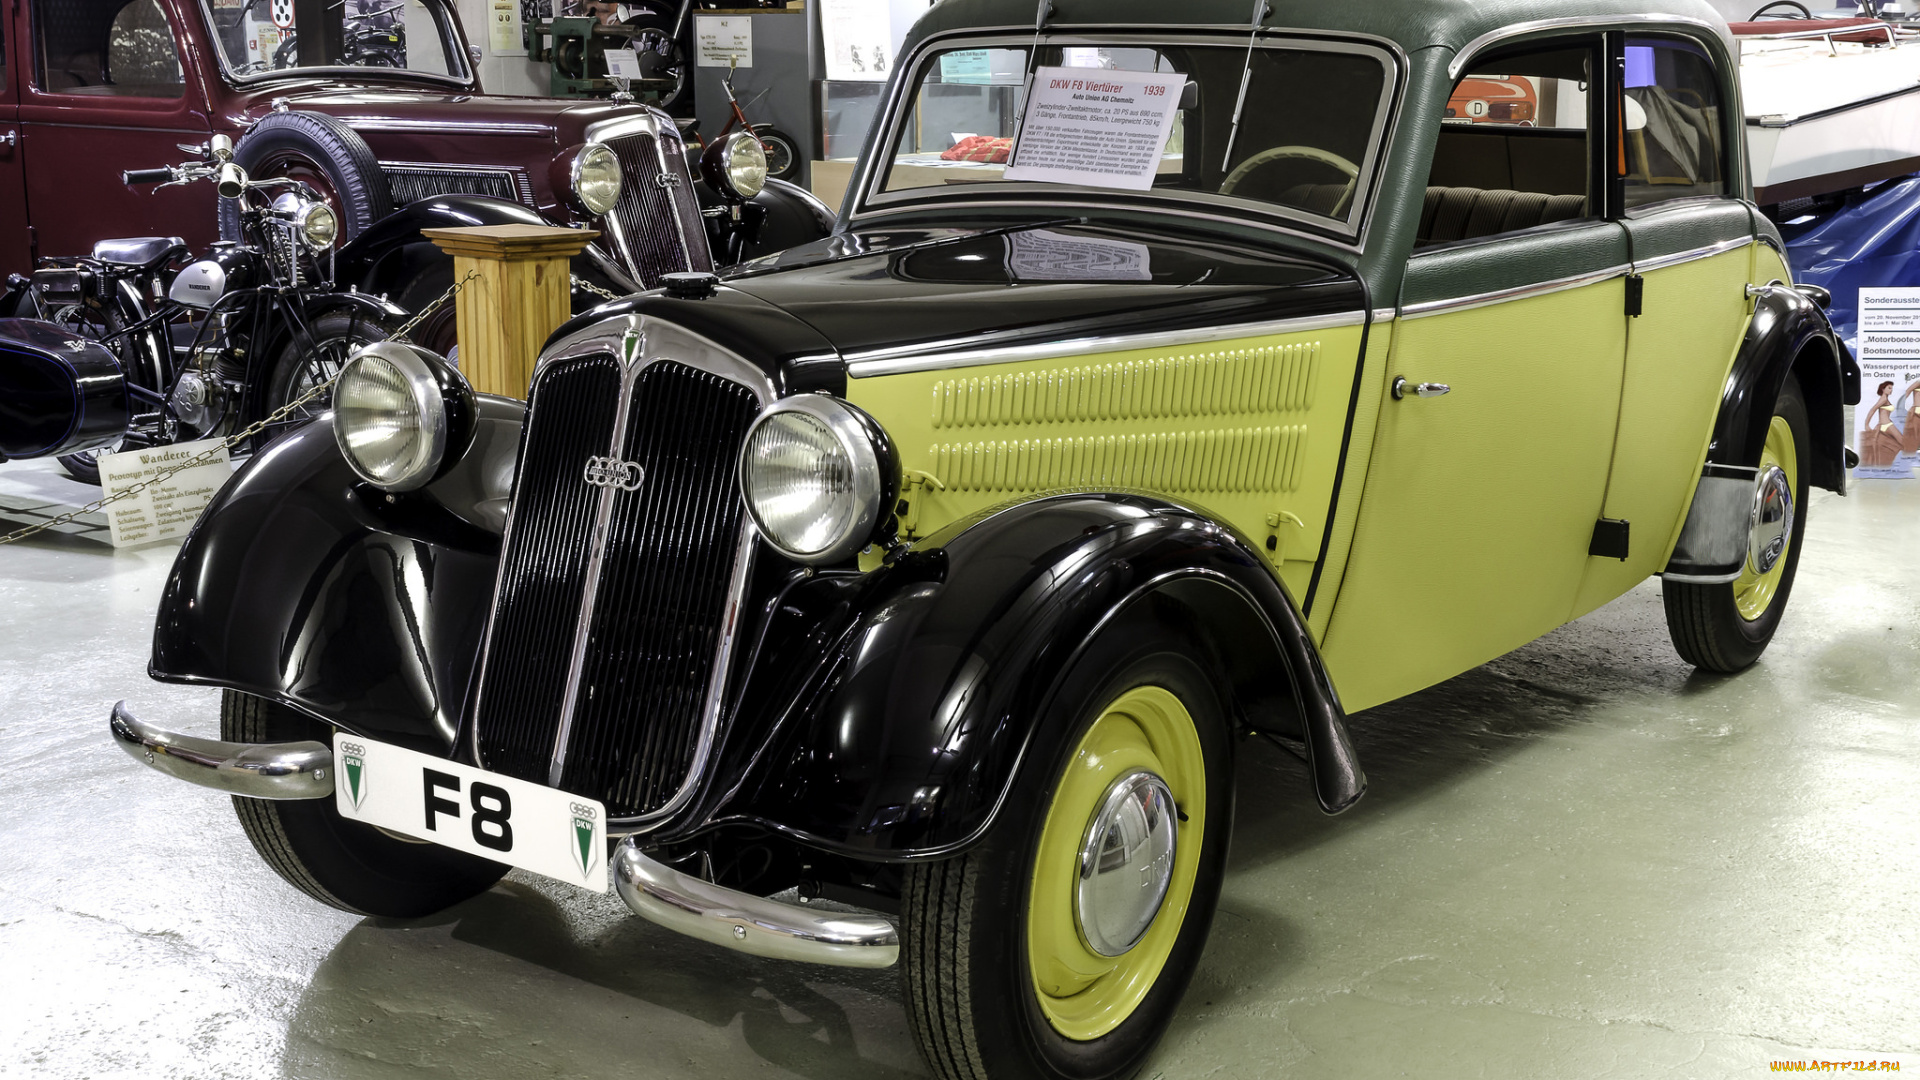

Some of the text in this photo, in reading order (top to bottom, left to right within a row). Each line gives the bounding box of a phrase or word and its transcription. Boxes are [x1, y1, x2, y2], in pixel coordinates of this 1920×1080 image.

[1049, 79, 1165, 96] DKW F8 Viertürer 1939
[1110, 96, 1135, 104] Chemnitz
[1474, 102, 1482, 114] D
[1863, 363, 1909, 371] Wassersport
[139, 450, 192, 465] Wanderer
[108, 467, 156, 481] Prototyp mit
[346, 757, 361, 768] DKW
[423, 767, 513, 852] F8
[575, 819, 592, 831] DKW
